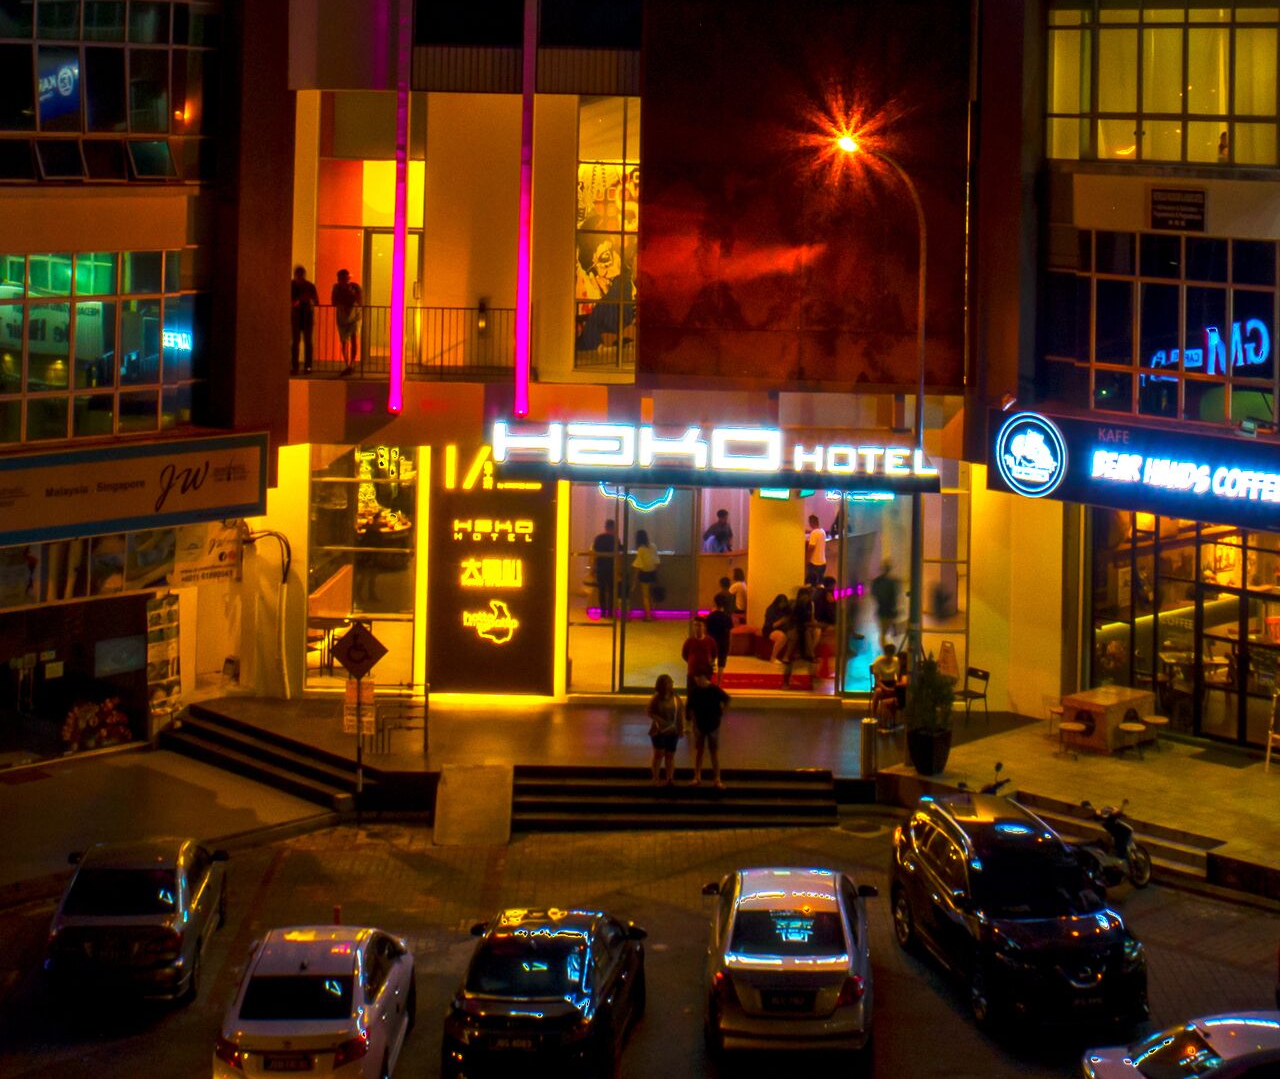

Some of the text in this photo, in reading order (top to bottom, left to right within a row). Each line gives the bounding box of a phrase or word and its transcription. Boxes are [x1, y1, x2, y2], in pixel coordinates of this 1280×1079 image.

[1098, 426, 1130, 444] KAFE
[793, 443, 940, 477] HOTEL
[45, 479, 146, 499] Malaysia Singapore
[154, 461, 209, 512] JW
[1143, 456, 1211, 495] HANDS
[453, 533, 533, 542] HOTEL
